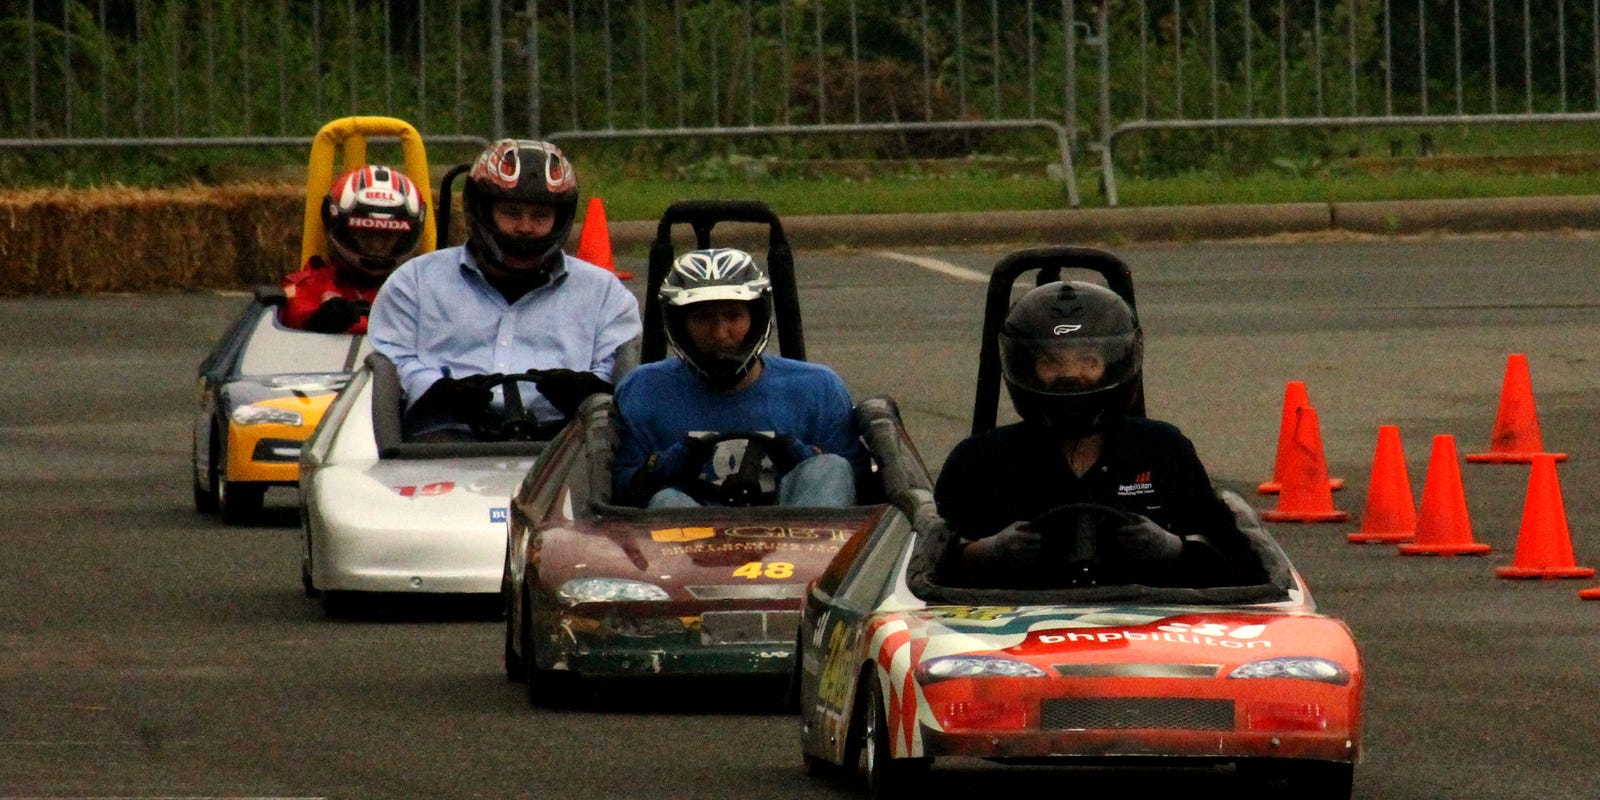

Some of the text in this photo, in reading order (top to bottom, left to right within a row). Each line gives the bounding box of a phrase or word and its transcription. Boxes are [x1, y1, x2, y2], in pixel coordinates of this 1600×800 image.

[365, 191, 395, 201] BELL
[348, 217, 411, 232] HONDA
[732, 561, 795, 579] 48
[1038, 630, 1272, 649] bhpbilliton
